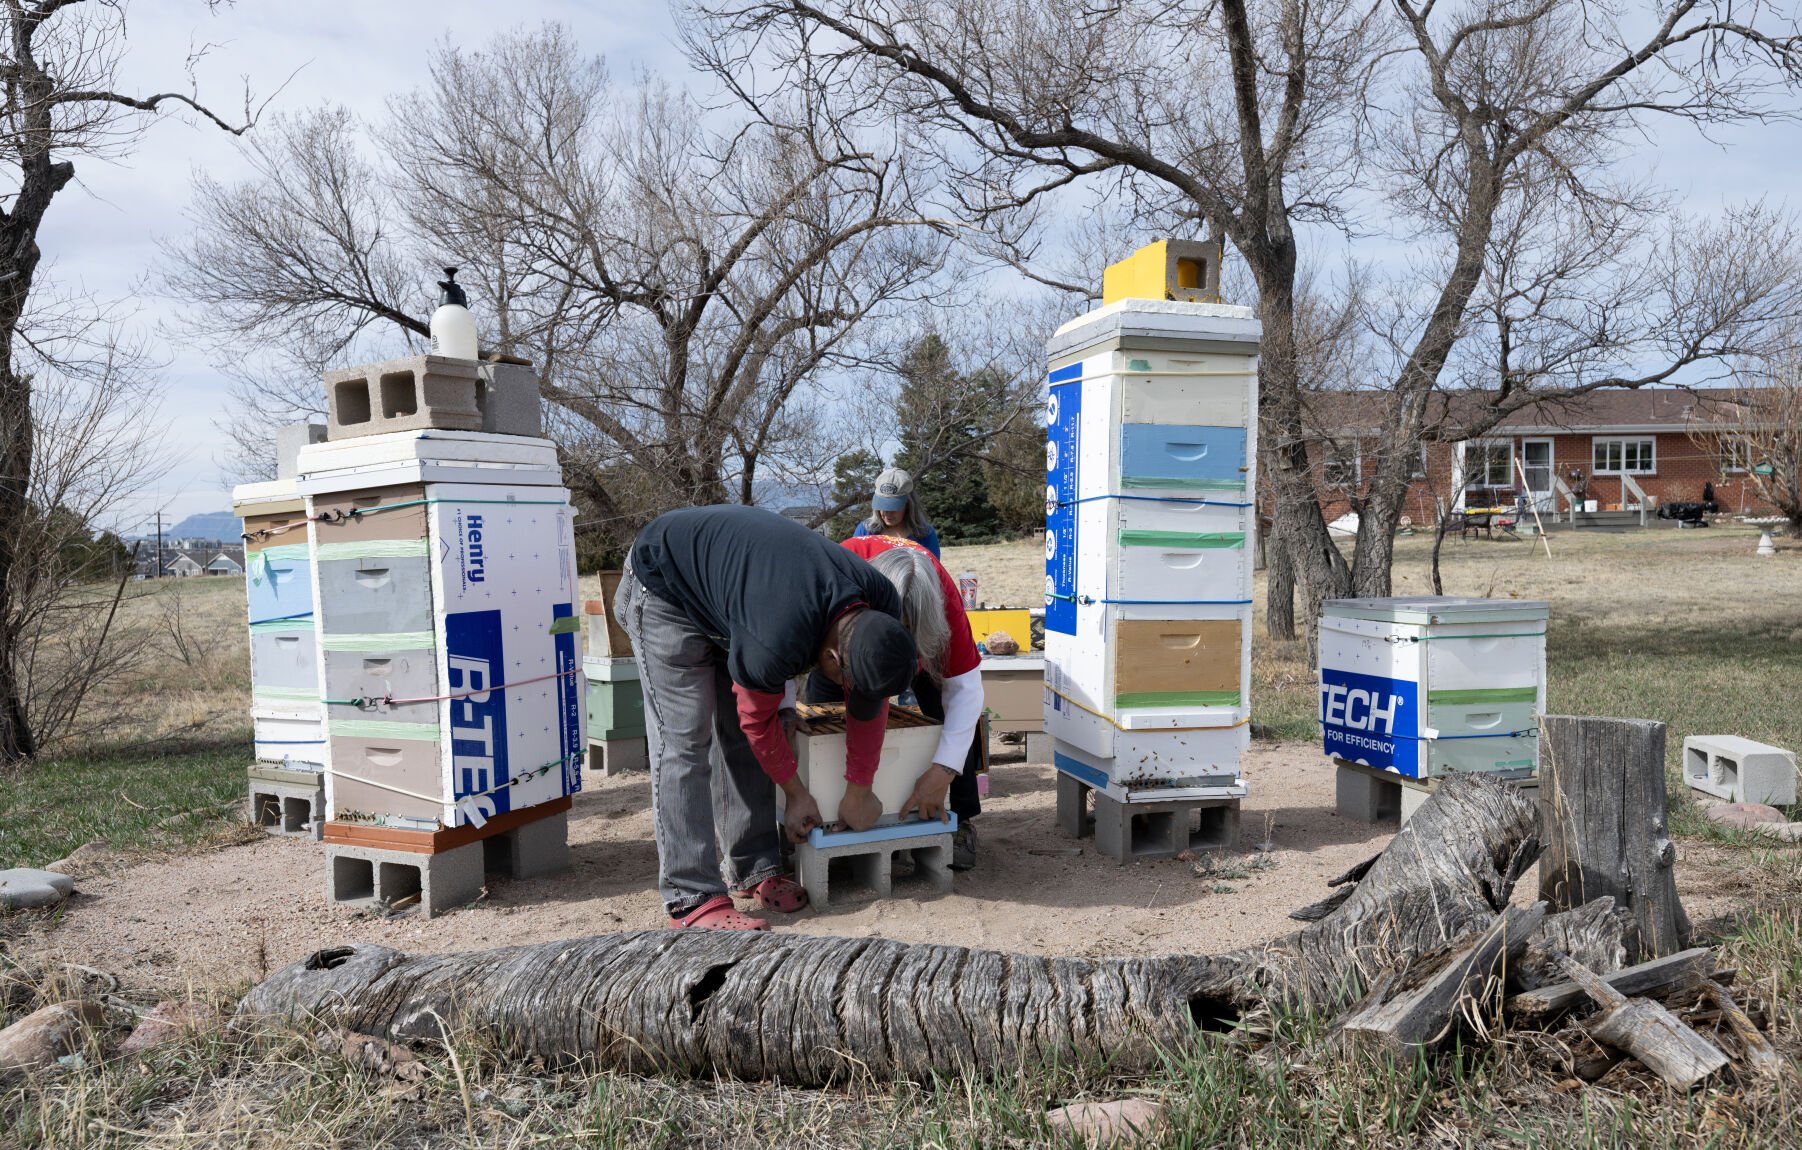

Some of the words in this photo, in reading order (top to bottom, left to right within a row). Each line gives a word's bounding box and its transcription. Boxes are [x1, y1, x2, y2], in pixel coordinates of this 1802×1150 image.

[459, 537, 464, 546] OF
[467, 515, 485, 582] Henry
[1322, 683, 1397, 738] ECH
[1327, 729, 1344, 743] FOR
[1345, 733, 1395, 755] EFFICIENCY
